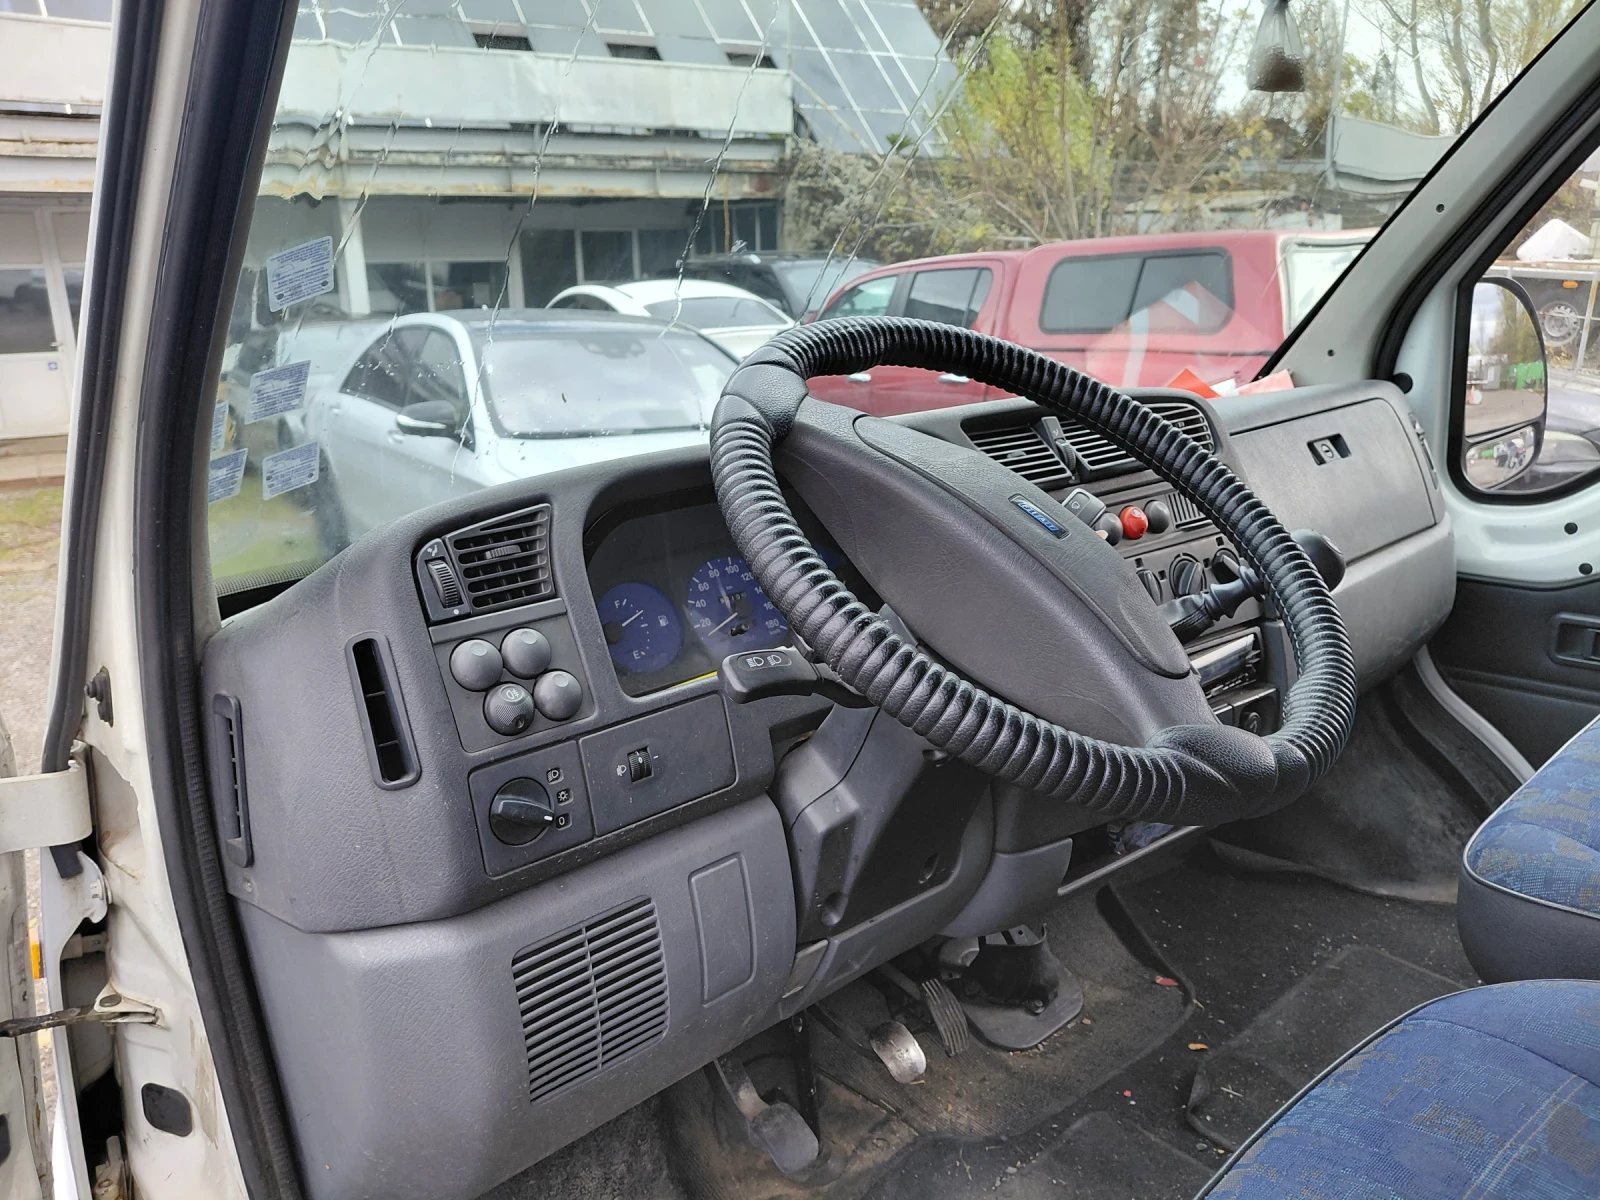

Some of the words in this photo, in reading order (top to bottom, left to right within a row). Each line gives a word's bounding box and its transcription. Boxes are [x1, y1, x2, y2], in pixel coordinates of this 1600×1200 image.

[708, 569, 720, 579] 80
[725, 564, 740, 575] 100
[698, 582, 710, 592] 60
[754, 586, 763, 594] 14
[614, 599, 621, 609] F
[695, 599, 707, 608] 40
[700, 618, 711, 627] 20
[765, 618, 780, 629] 180
[632, 650, 641, 660] E
